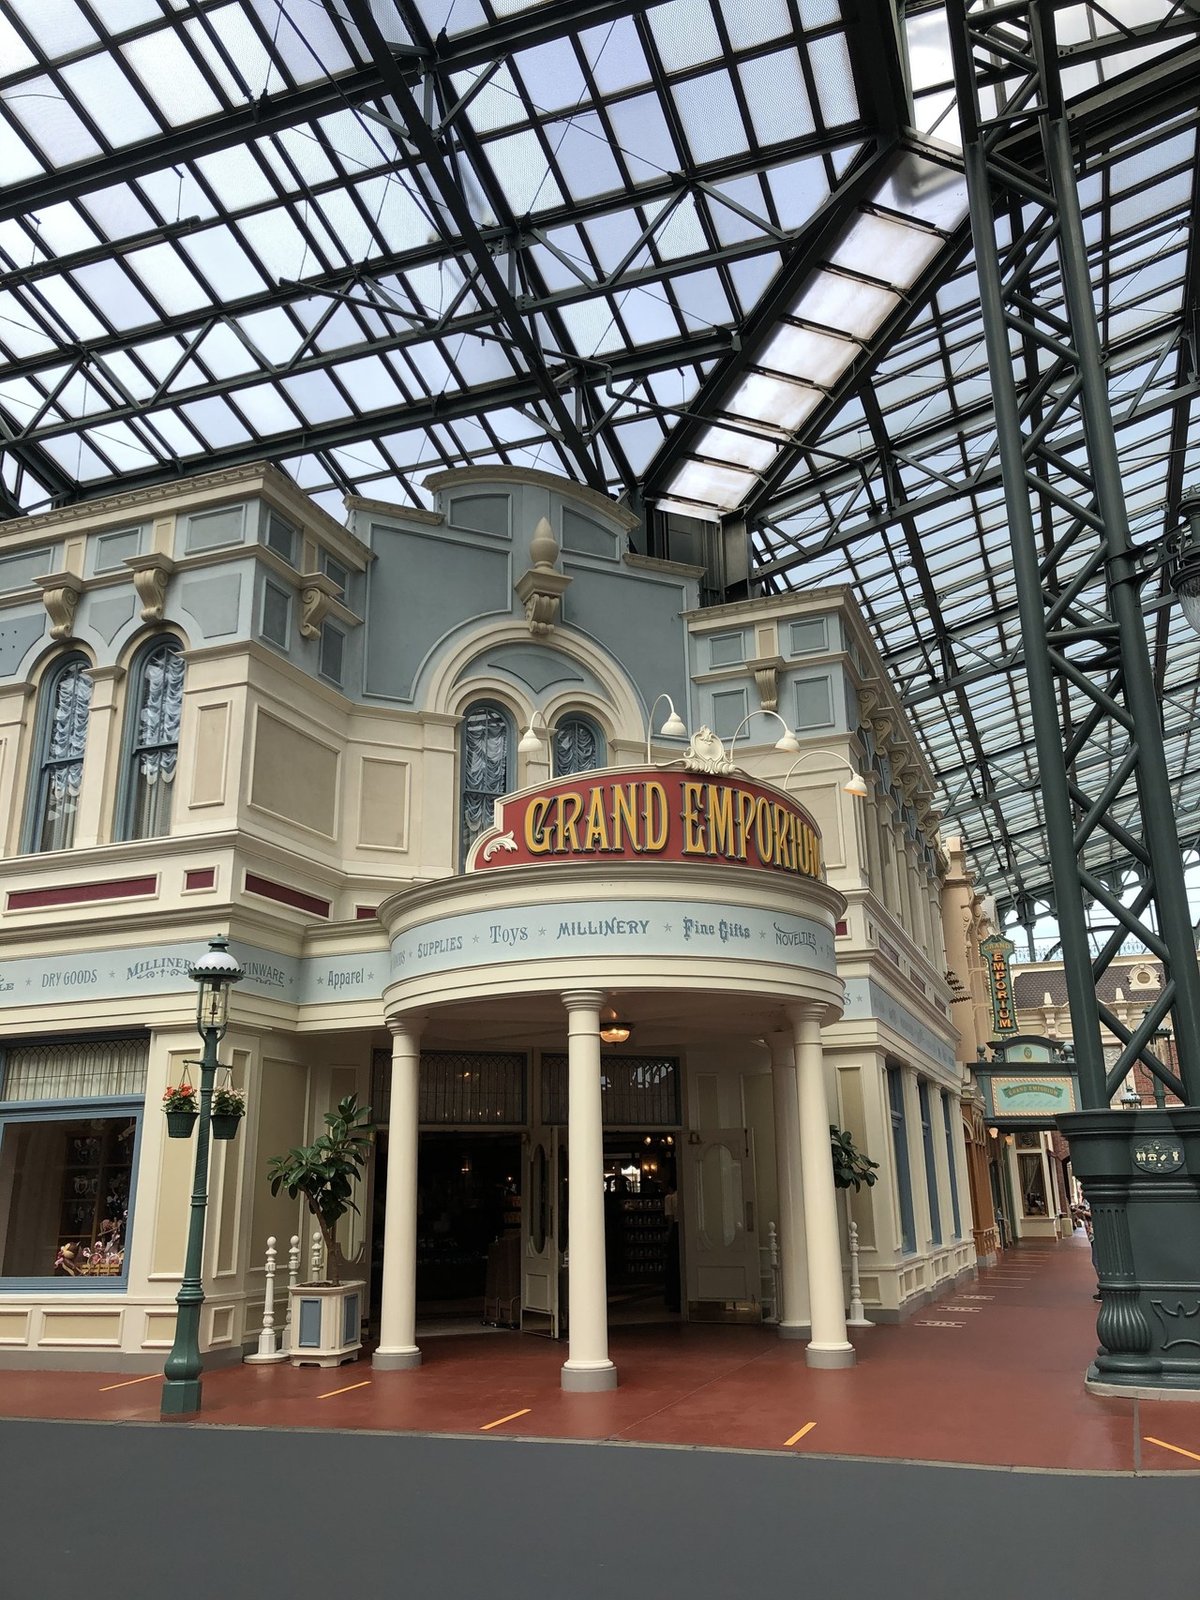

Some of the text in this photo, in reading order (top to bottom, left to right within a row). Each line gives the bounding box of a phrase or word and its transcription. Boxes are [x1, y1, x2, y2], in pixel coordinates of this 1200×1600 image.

[524, 781, 820, 879] GRAND EMPORIUM
[489, 924, 529, 946] Toys
[556, 916, 650, 940] MILLINERY
[682, 916, 751, 943] Fine Gifts
[774, 927, 818, 951] NOVELTIES
[417, 935, 463, 959] SUPPLIES
[41, 968, 98, 988] DRY GOODS
[126, 957, 197, 981] MILLINER
[327, 967, 364, 990] Apparel
[991, 953, 1014, 1029] EMPORIUM
